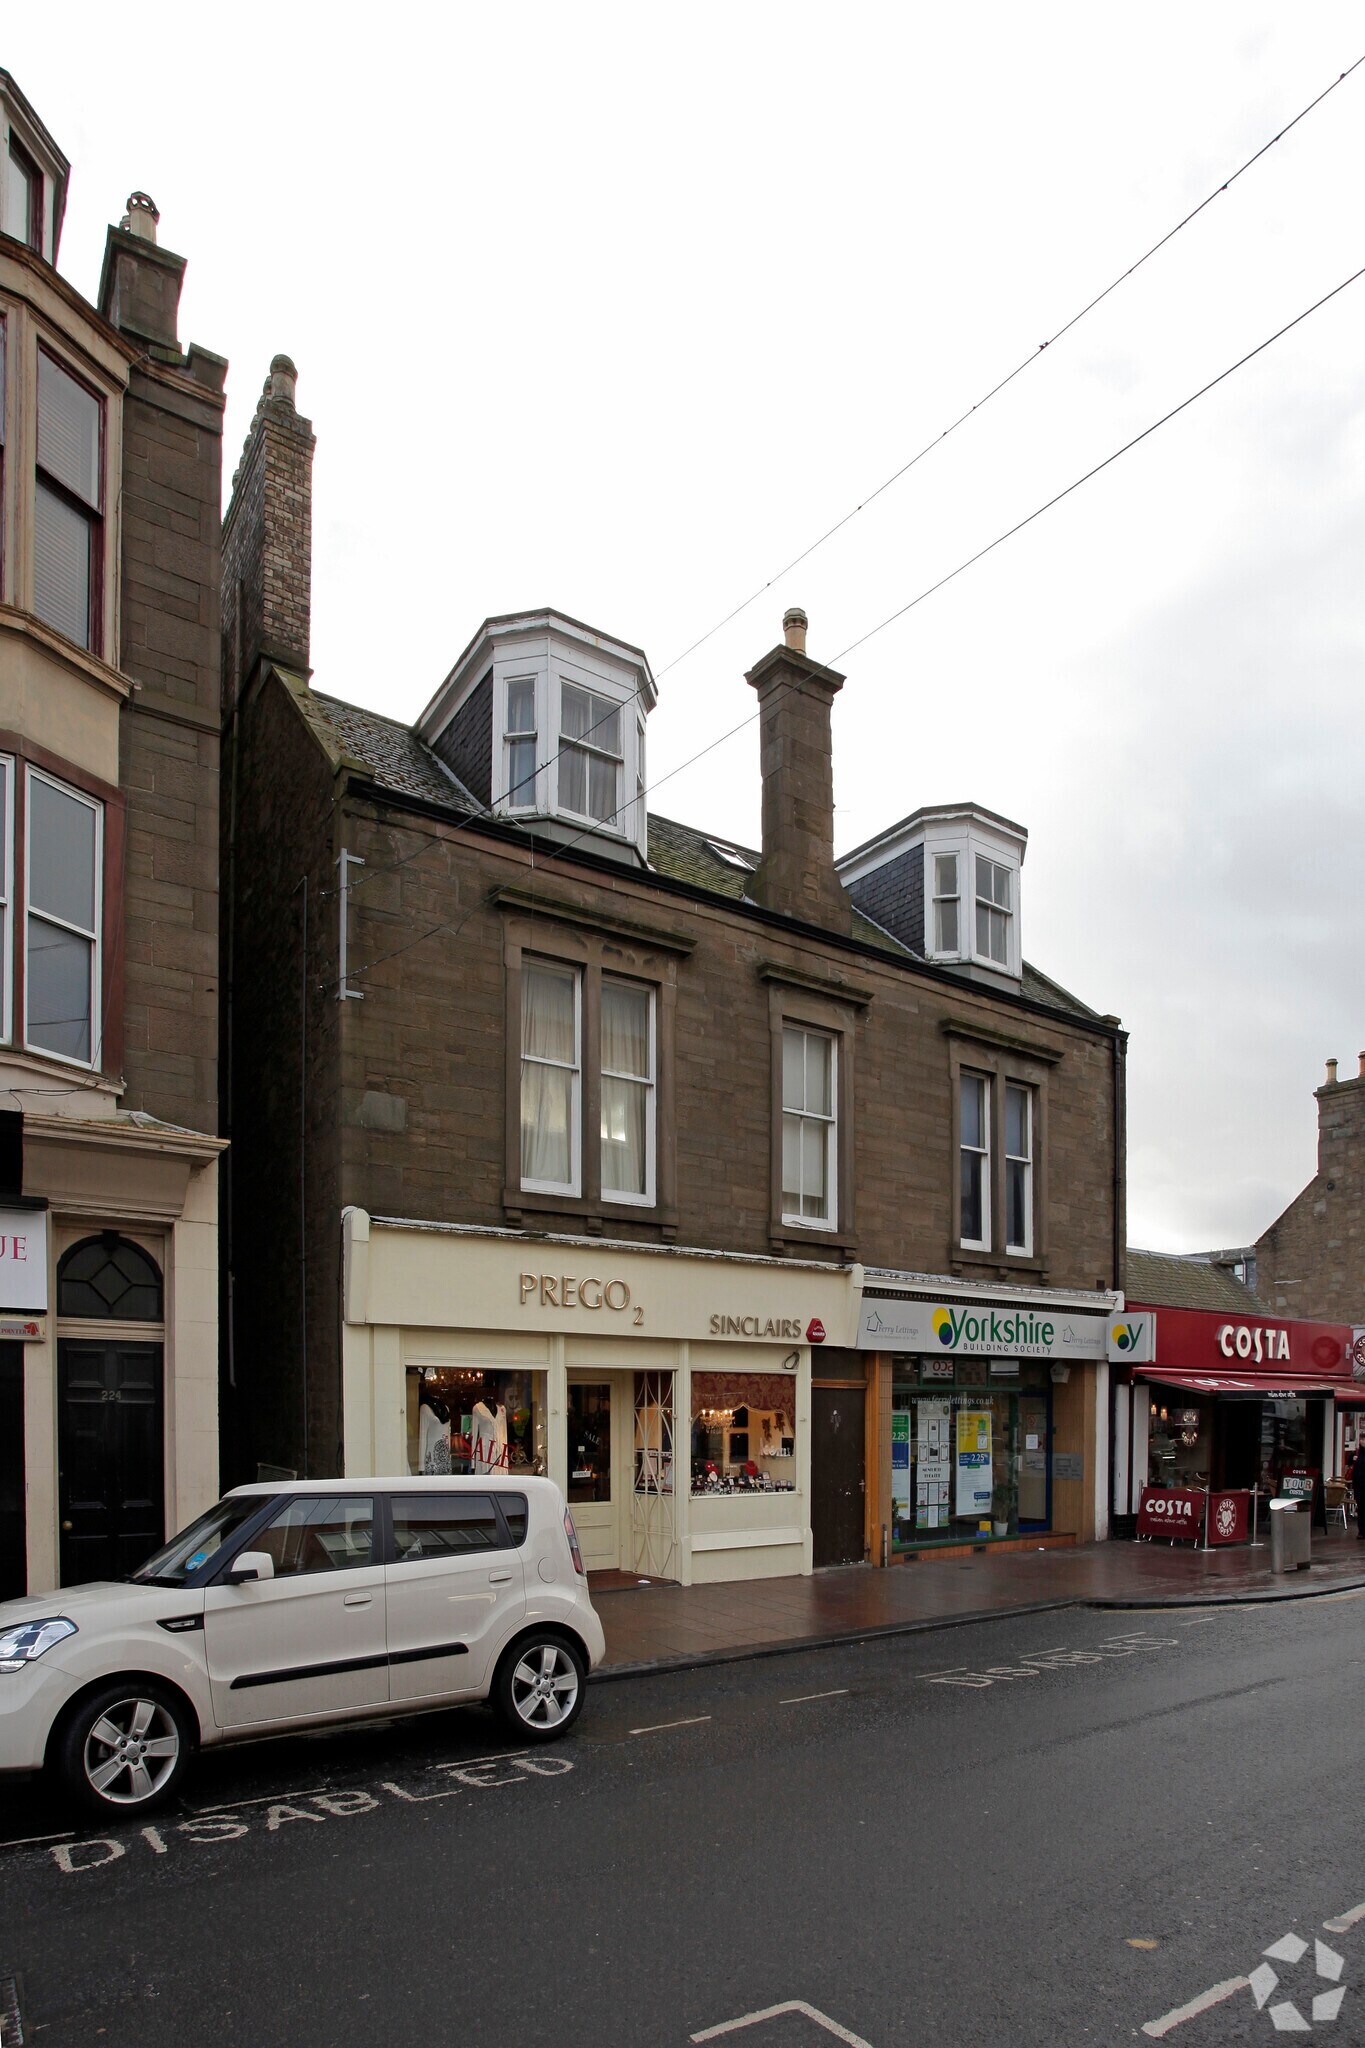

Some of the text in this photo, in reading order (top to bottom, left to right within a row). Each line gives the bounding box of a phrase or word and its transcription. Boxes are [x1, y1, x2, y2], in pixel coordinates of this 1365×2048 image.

[519, 1272, 644, 1325] PREGO 2
[709, 1313, 802, 1339] SINCLAIRS
[949, 1308, 1055, 1350] Yorkshire
[963, 1342, 1009, 1353] BUILDING
[1014, 1345, 1052, 1356] SOCIETY
[1219, 1325, 1291, 1364] COSTA
[101, 1390, 121, 1401] 224
[456, 1432, 517, 1470] SALE
[584, 1431, 600, 1445] SALE
[1283, 1478, 1313, 1491] YOUR
[1145, 1499, 1192, 1517] COSTA
[1219, 1500, 1234, 1512] COSTA
[929, 1637, 1179, 1688] DISABLED
[50, 1757, 574, 1873] DISABLED
